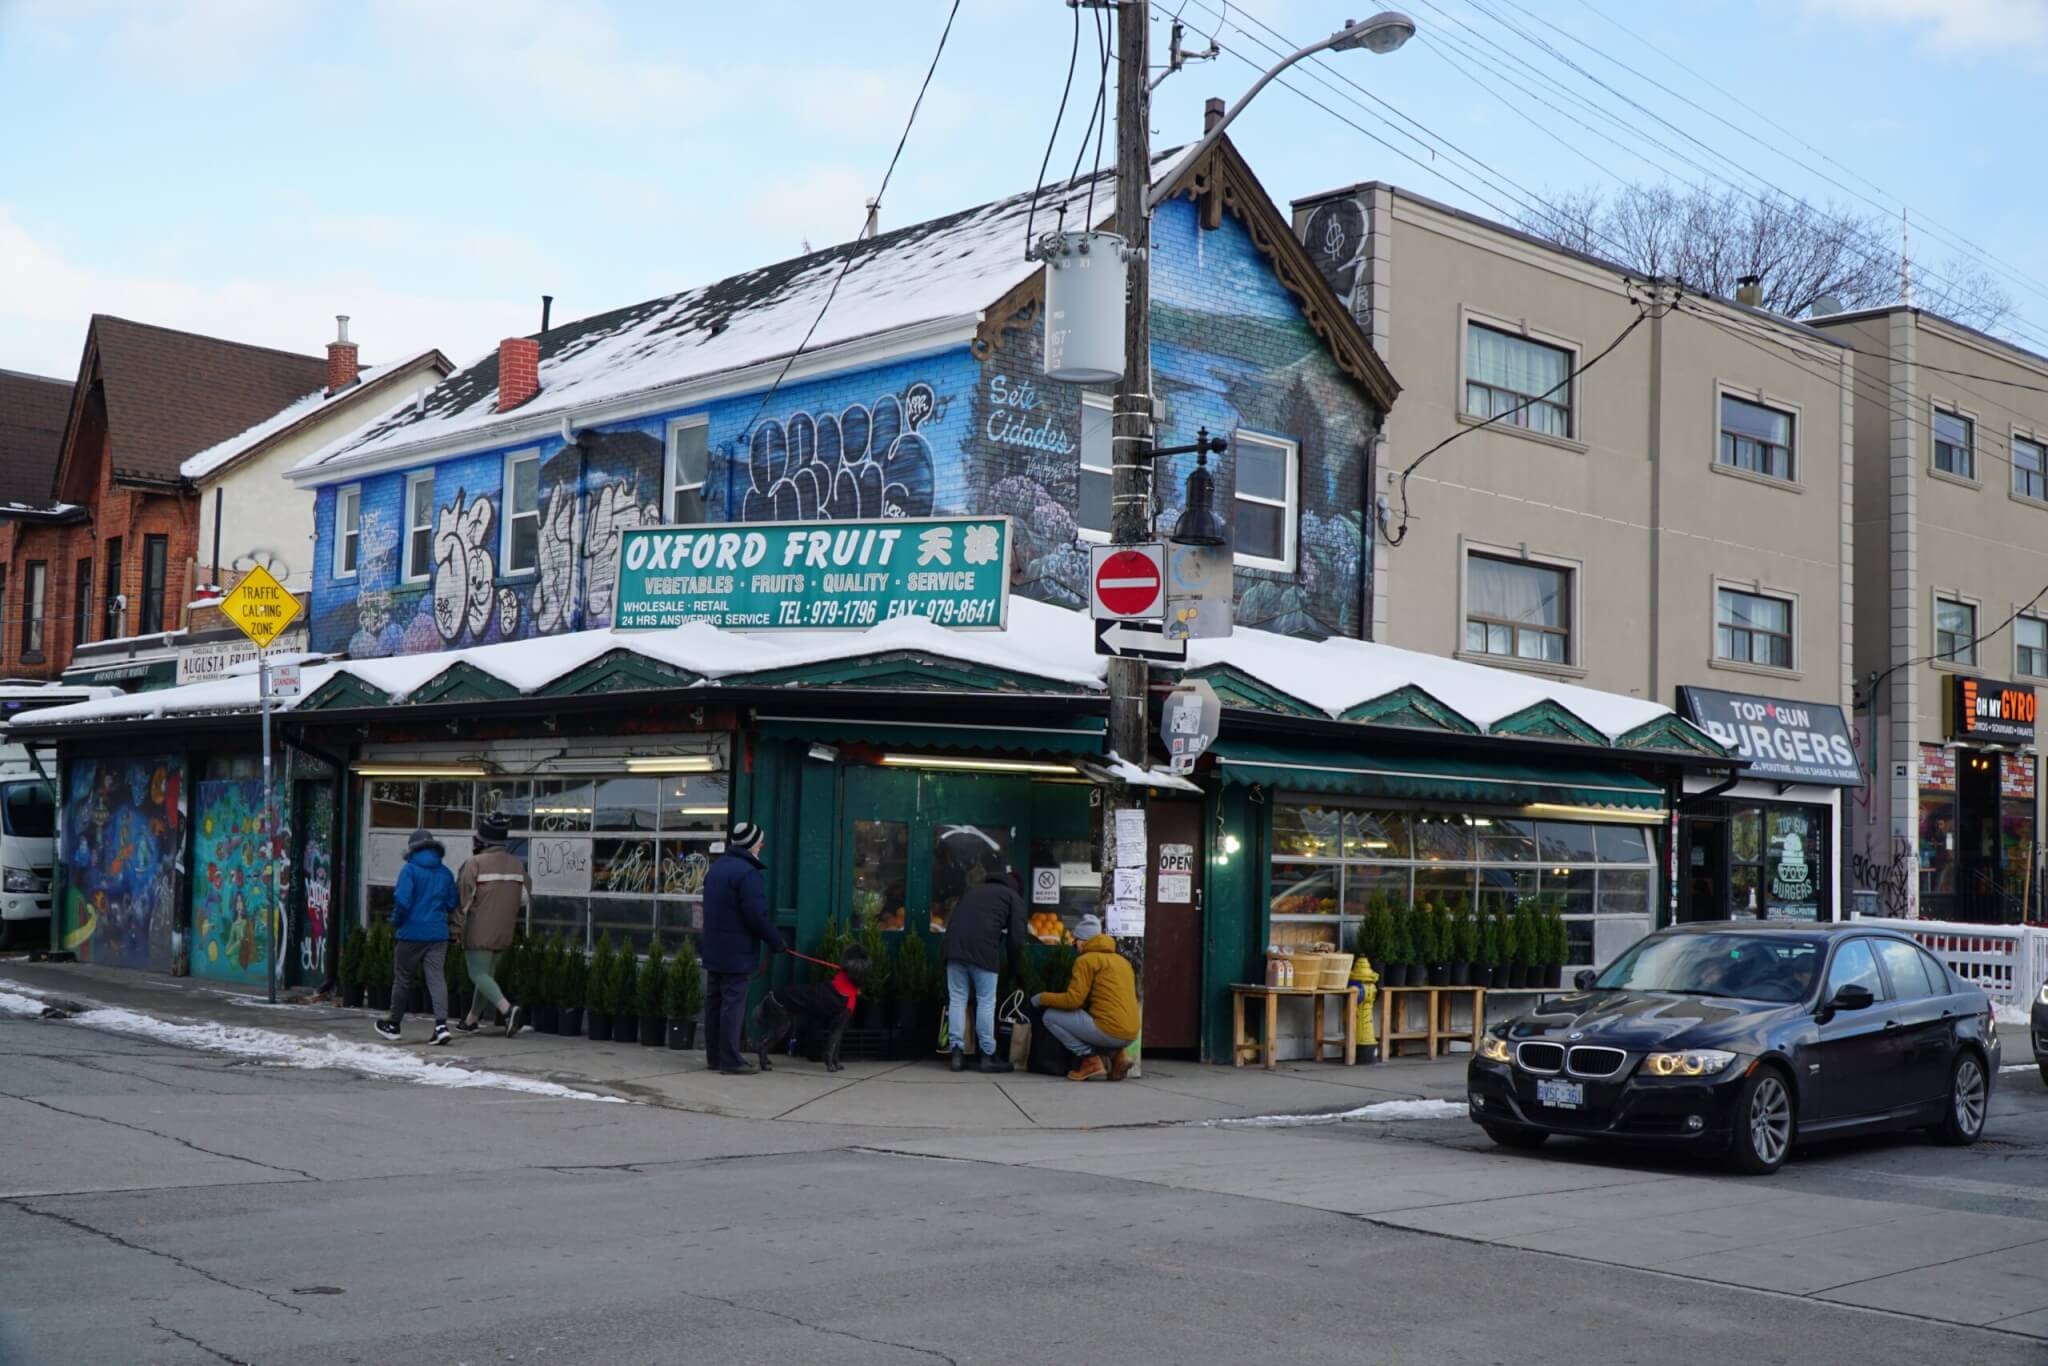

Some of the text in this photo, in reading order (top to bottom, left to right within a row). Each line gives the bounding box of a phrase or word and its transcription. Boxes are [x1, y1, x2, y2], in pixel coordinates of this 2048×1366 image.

[991, 375, 1041, 410] Sete
[987, 409, 1076, 454] Cidades
[626, 529, 902, 571] OXFORD FRUIT
[242, 586, 280, 600] TRAFFIC
[644, 571, 975, 595] VEGETABLES FRUITS QUALITY SERVICE
[242, 604, 282, 618] CALMING
[623, 600, 729, 613] WHOLESALE RETAIL
[251, 622, 273, 636] ZONE
[621, 613, 770, 626] 24 HRS ANSWERING SERVICE
[183, 656, 224, 675] AUGUSTA
[1730, 701, 1766, 721] TOP
[1775, 707, 1810, 728] GUN
[1976, 697, 1988, 716] OH
[1989, 698, 2001, 718] MY
[1160, 855, 1192, 870] OPEN
[1772, 878, 1813, 900] BURGERS
